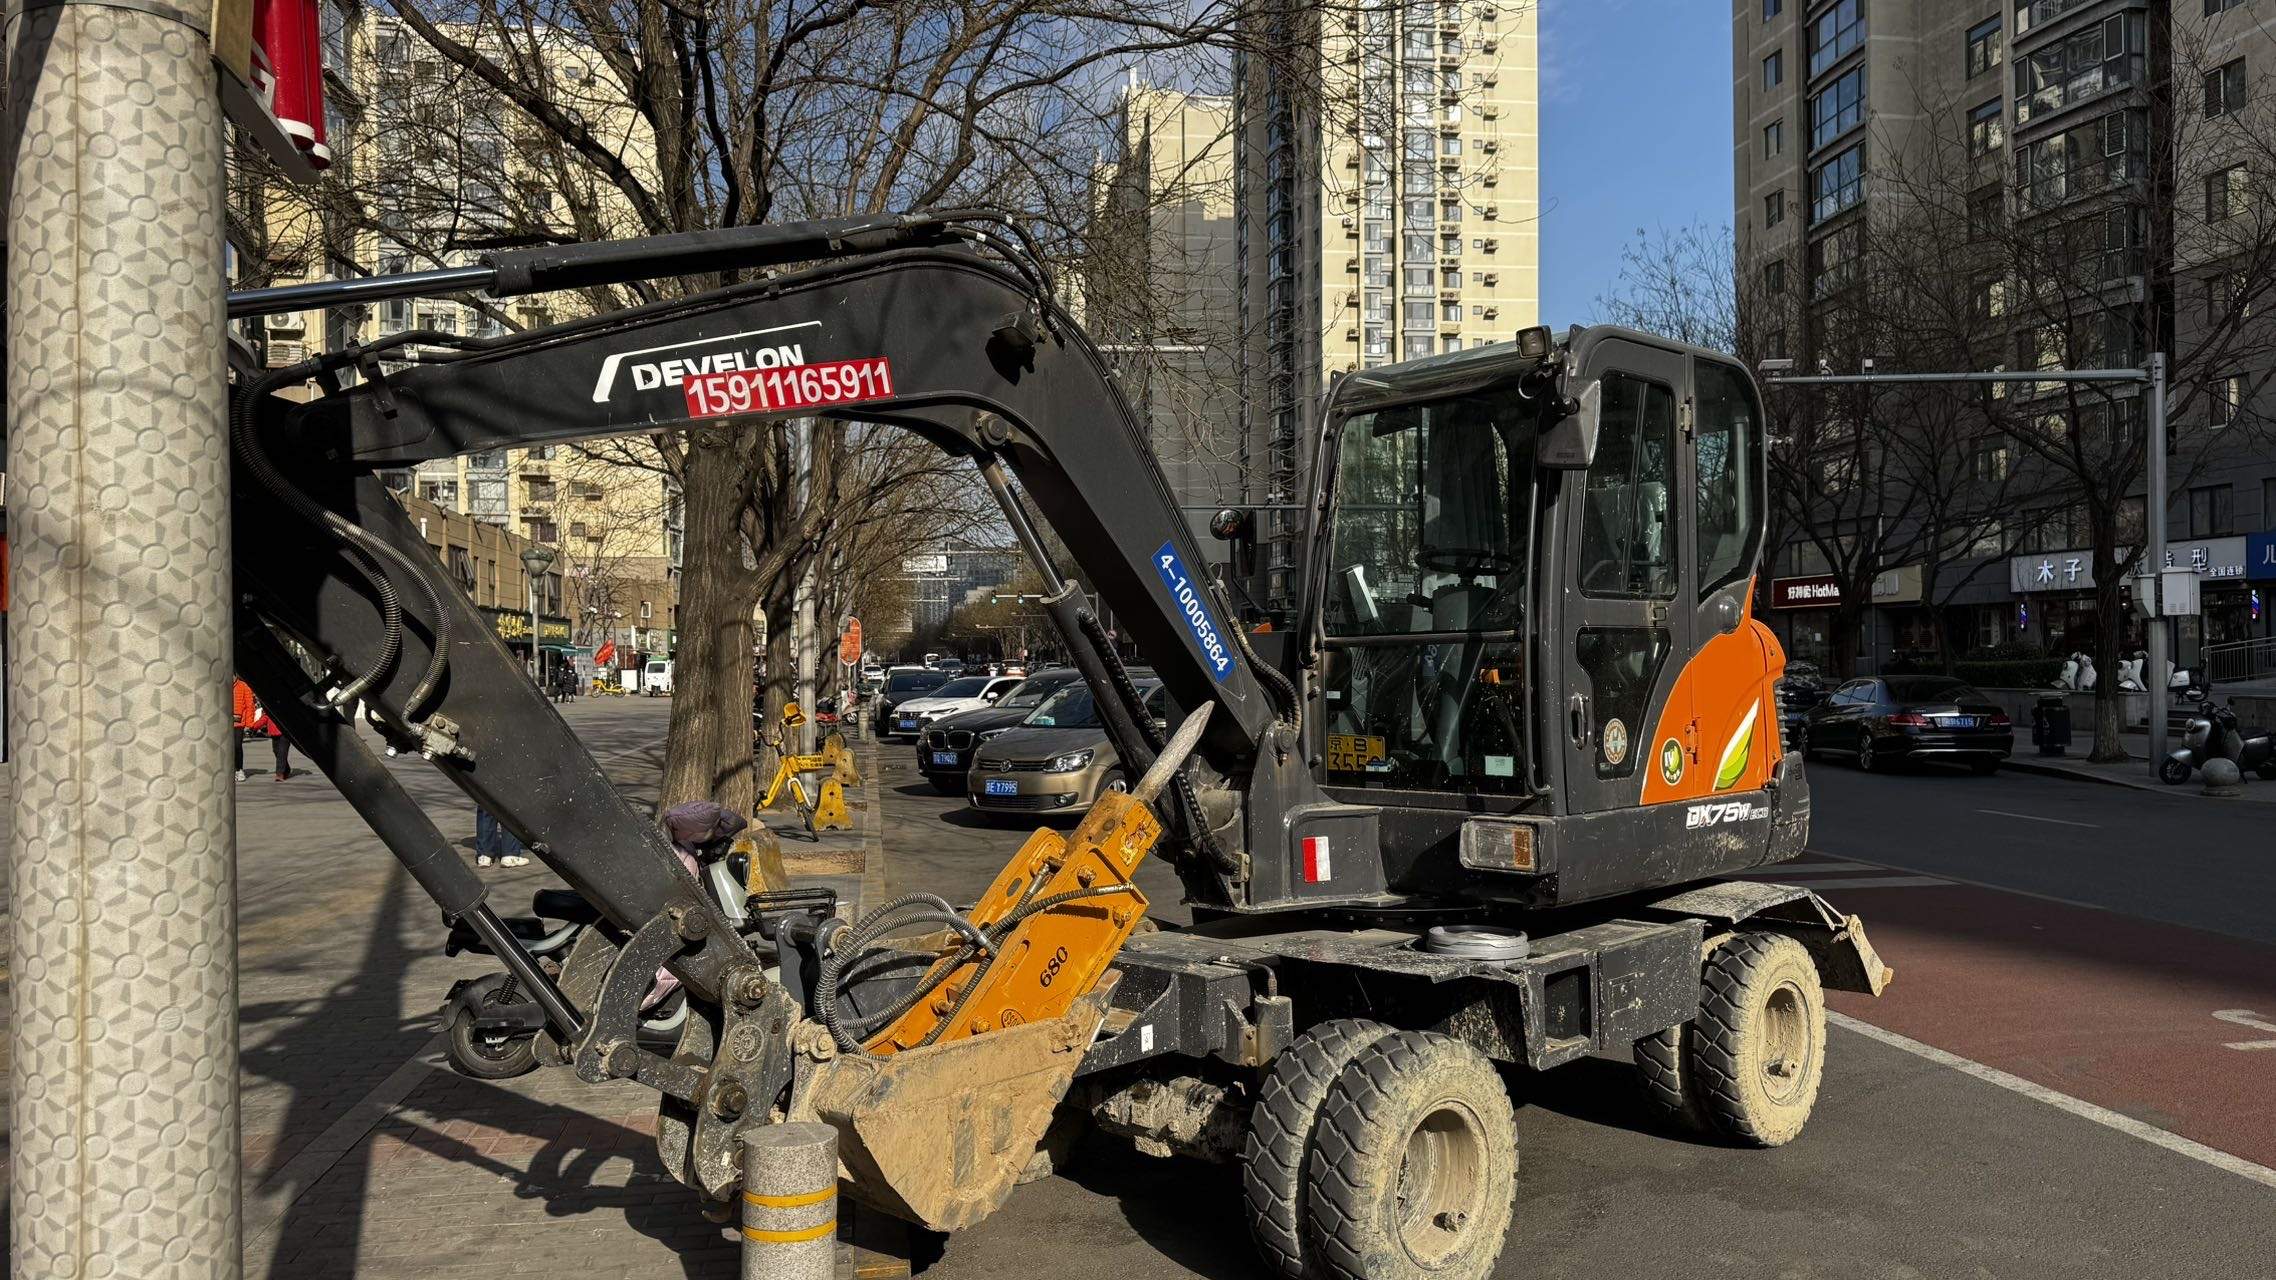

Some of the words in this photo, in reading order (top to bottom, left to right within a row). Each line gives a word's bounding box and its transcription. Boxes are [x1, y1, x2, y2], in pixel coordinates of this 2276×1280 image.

[631, 344, 805, 391] DEVELON
[687, 361, 890, 415] 15911165911
[2036, 558, 2083, 584] 木子
[1040, 946, 1069, 988] 680
